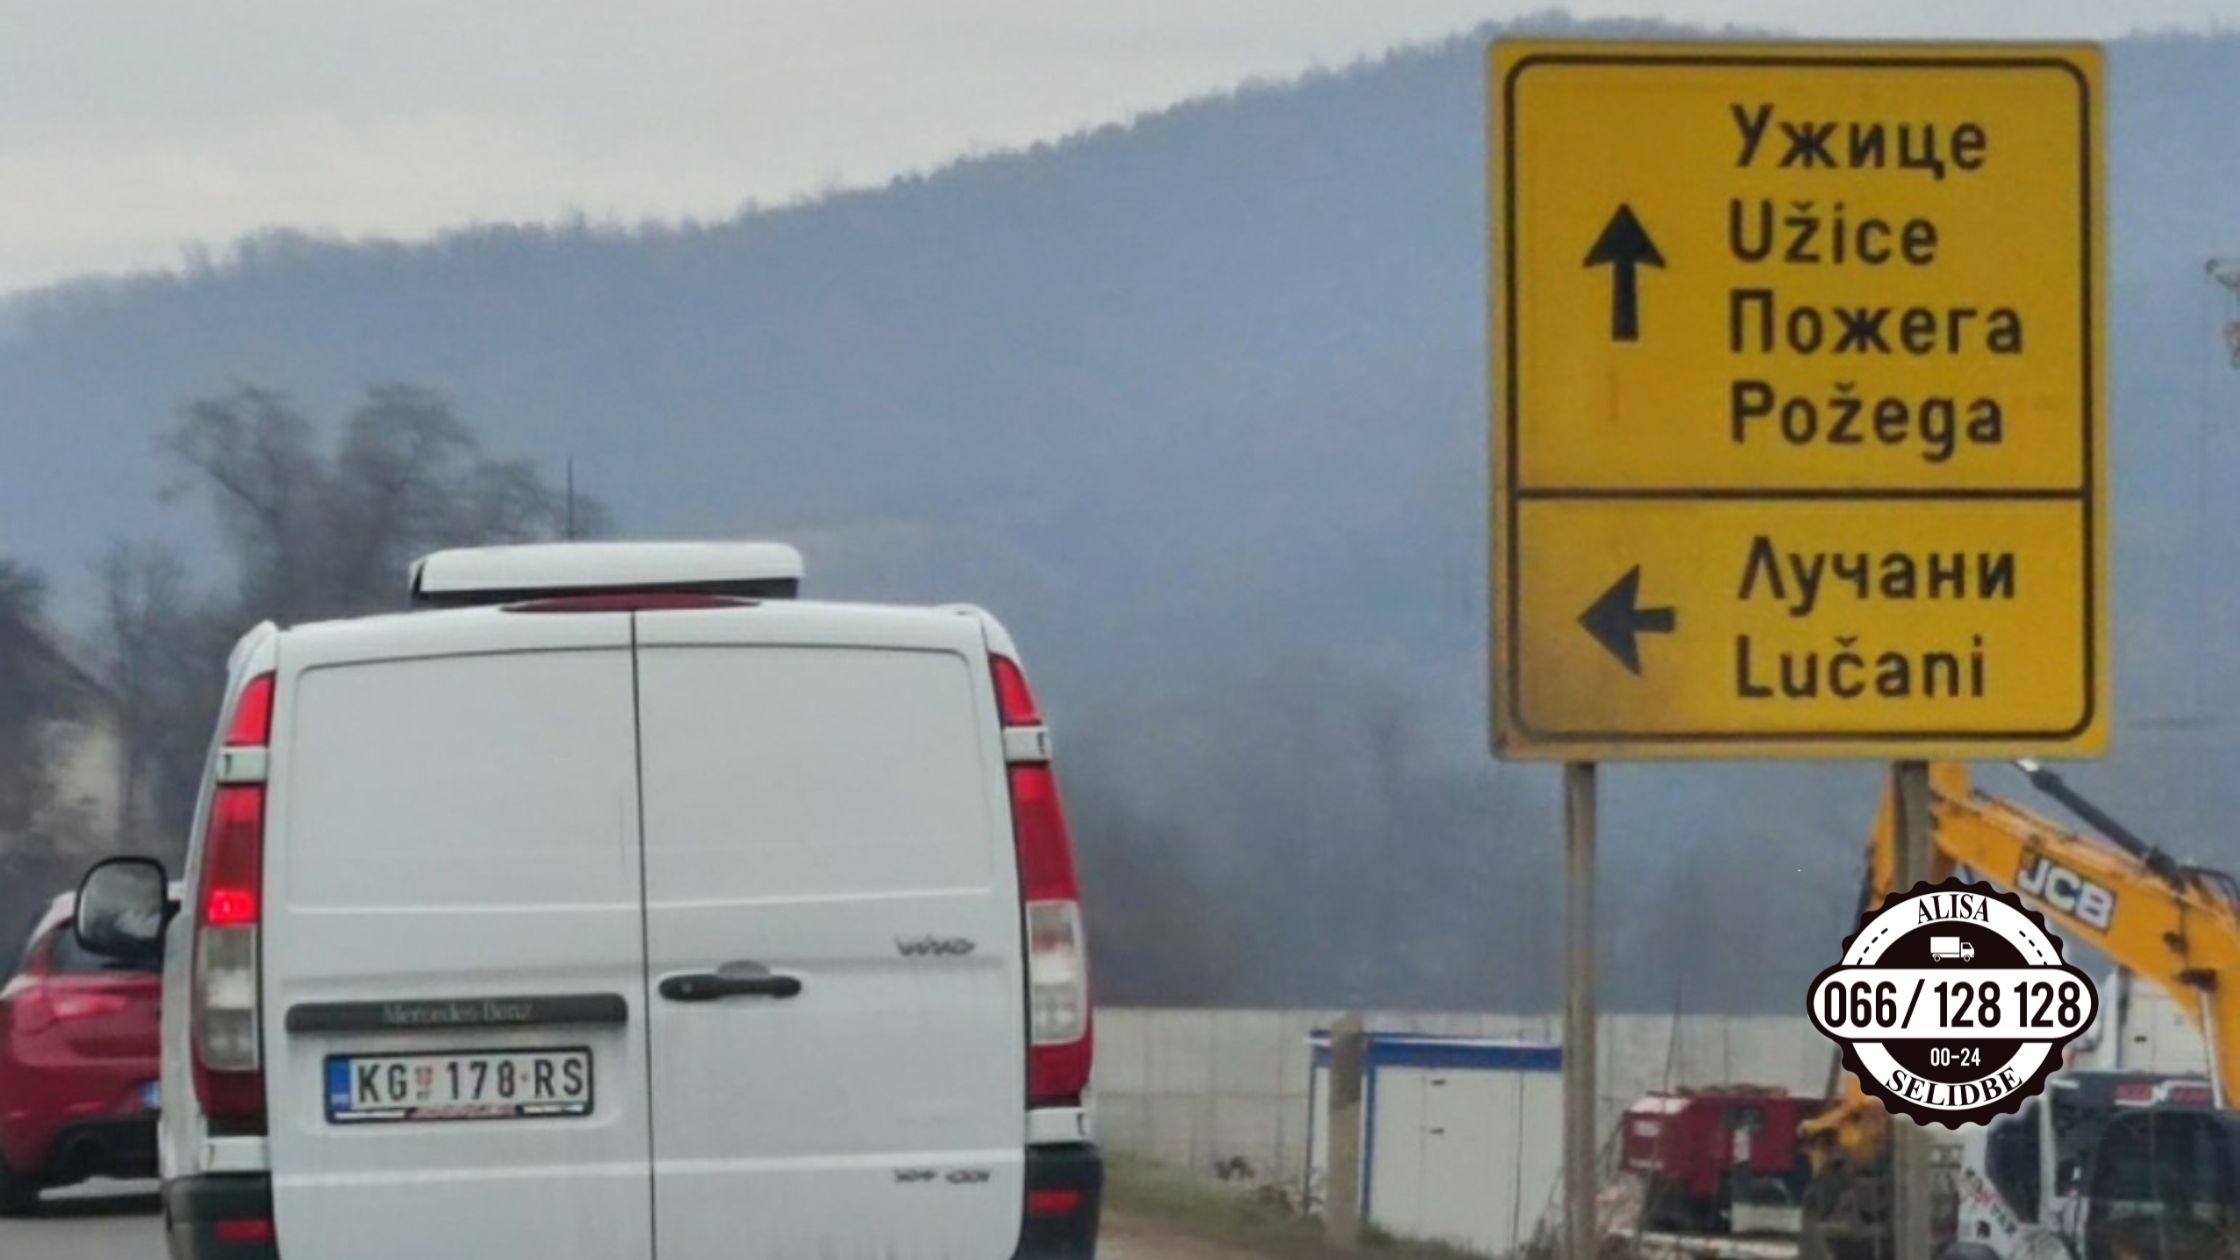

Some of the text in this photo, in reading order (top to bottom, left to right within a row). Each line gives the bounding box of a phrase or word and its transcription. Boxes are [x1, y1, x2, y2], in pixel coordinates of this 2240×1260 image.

[1731, 104, 1987, 181] Ужице
[1729, 198, 1938, 266] Užice
[1729, 288, 2023, 356] Пожега
[1731, 379, 2003, 463] Požega
[1738, 535, 2016, 617] Лучани
[1737, 635, 1984, 699] Lučani
[2018, 858, 2114, 930] JCB
[358, 1063, 408, 1103] KG
